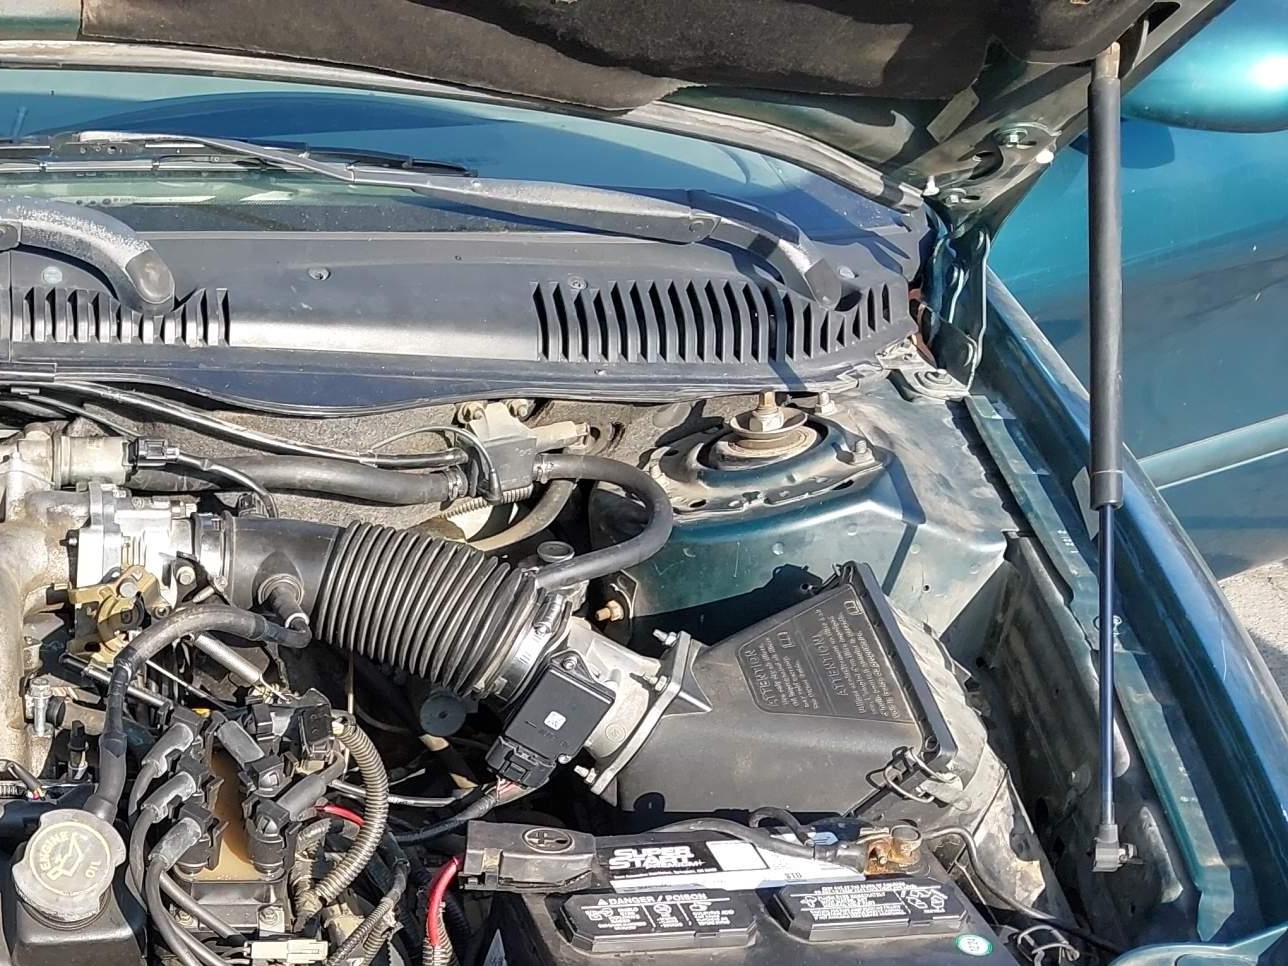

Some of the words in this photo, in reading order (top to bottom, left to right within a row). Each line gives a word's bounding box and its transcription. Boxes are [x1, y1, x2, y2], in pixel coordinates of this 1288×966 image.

[40, 831, 70, 871] ENGINE
[614, 846, 694, 858] SUPER
[85, 861, 102, 879] OIL
[608, 856, 689, 870] START
